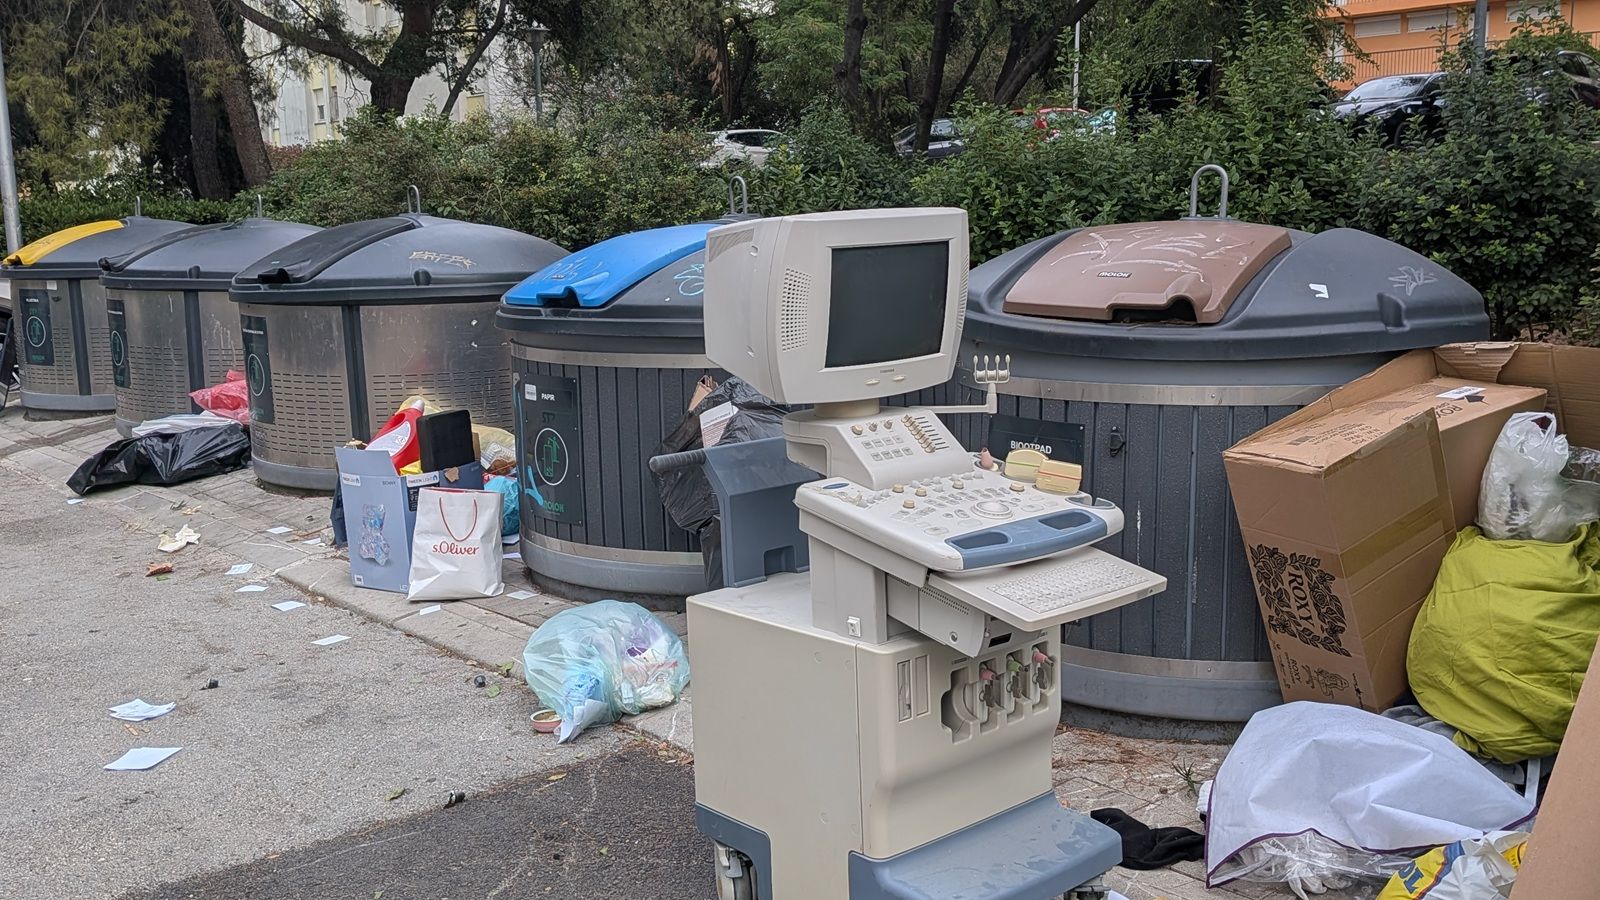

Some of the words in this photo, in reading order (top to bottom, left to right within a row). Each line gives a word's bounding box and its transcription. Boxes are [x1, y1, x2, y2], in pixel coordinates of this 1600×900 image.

[541, 393, 556, 401] PAPIR
[1010, 440, 1052, 454] BIOOTPAD
[432, 541, 479, 555] s.Oliver
[1288, 571, 1315, 628] ROXY
